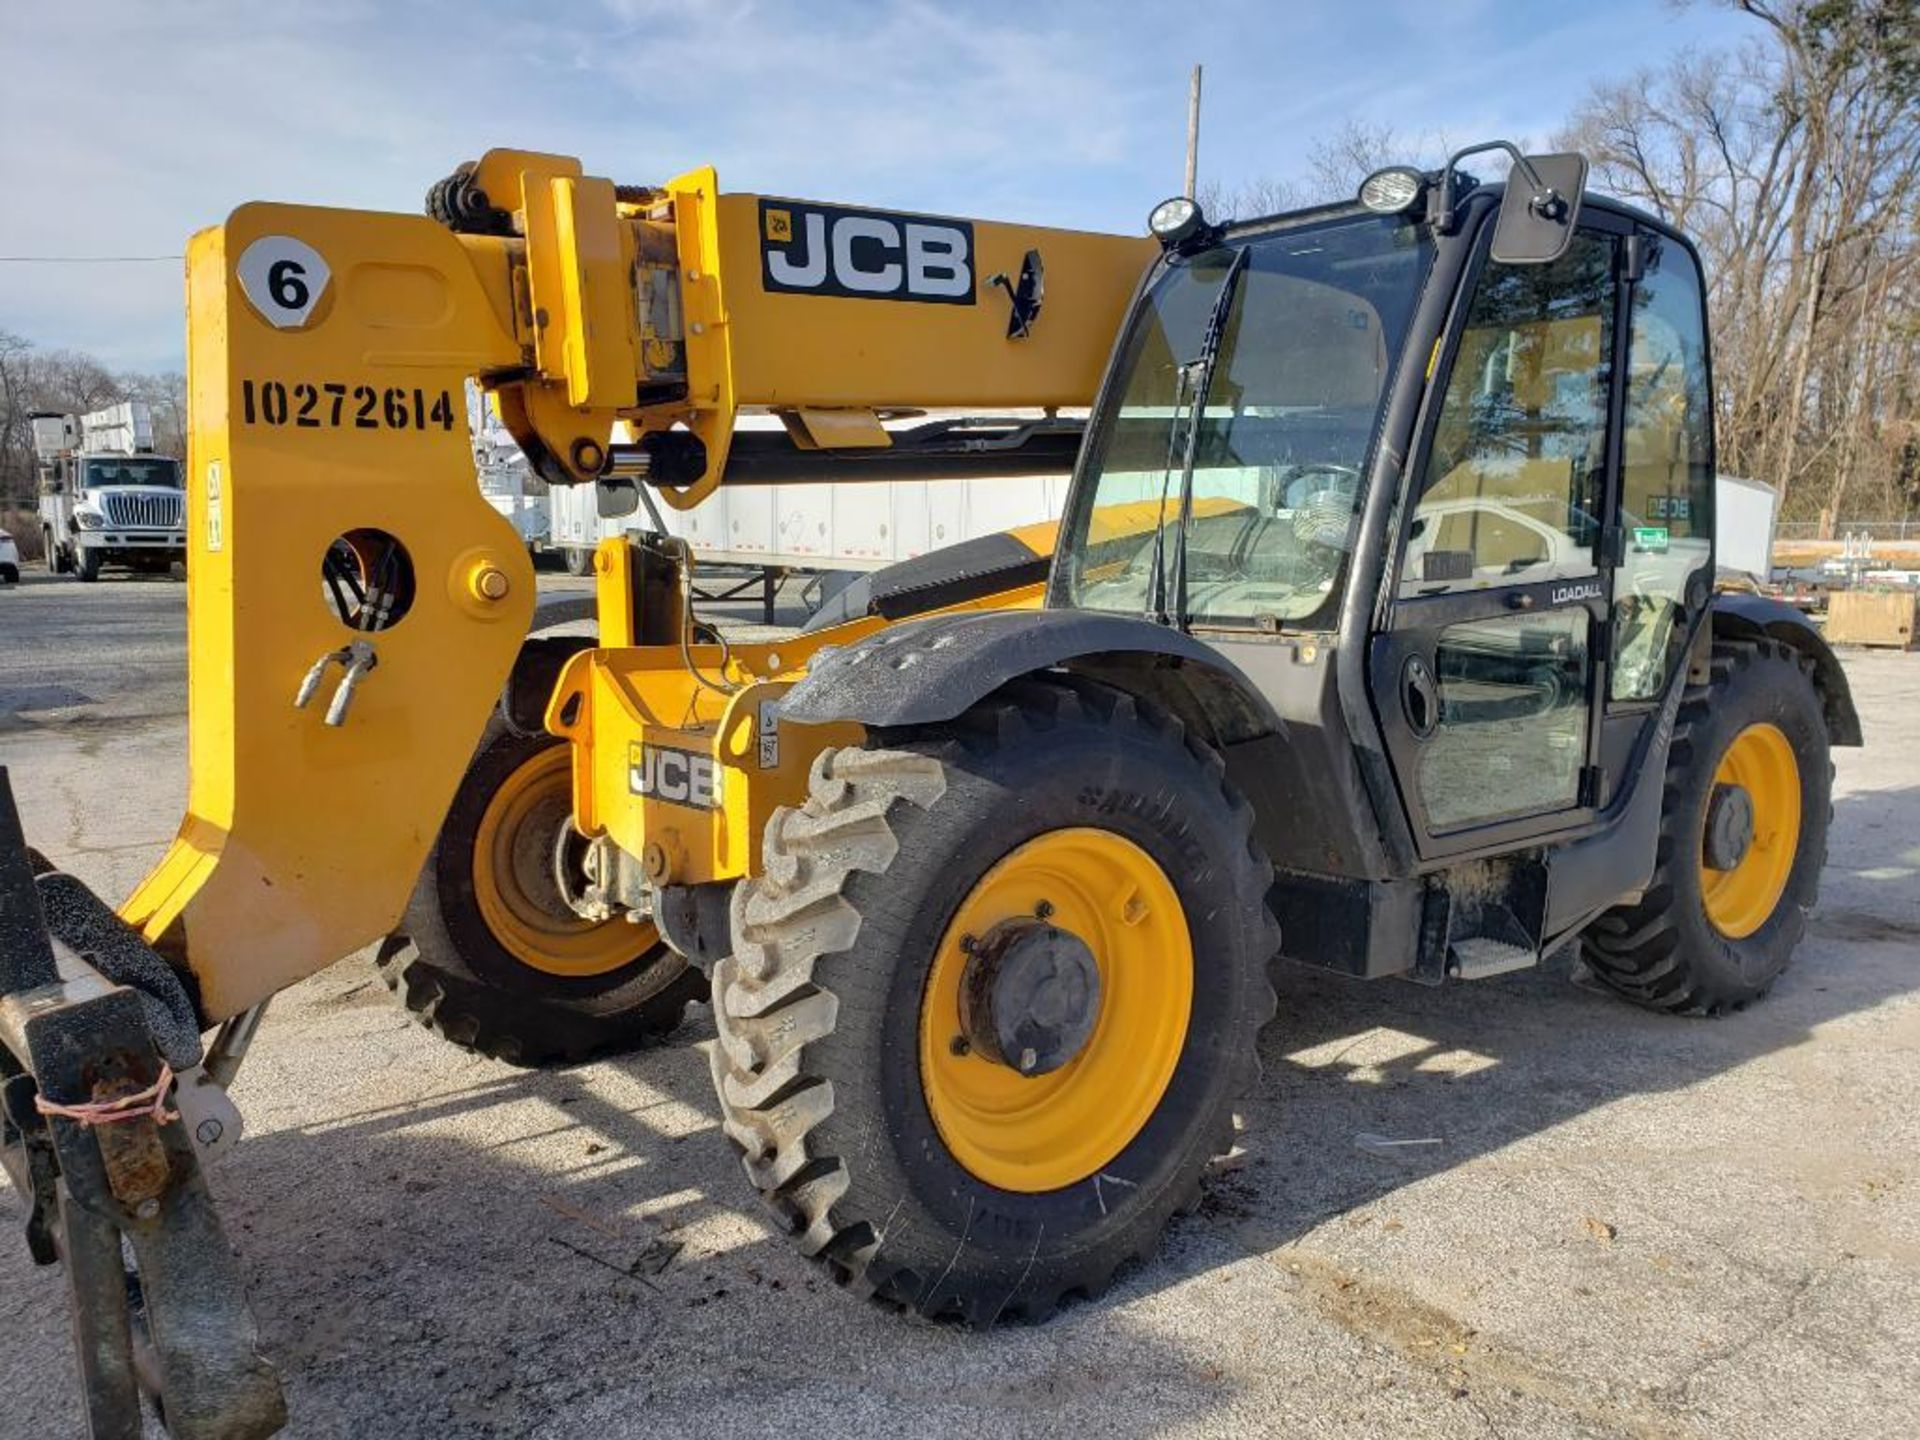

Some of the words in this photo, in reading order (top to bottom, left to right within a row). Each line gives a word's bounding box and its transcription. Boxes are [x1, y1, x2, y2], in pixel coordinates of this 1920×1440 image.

[768, 213, 971, 297] JCB
[268, 260, 309, 309] 6
[243, 380, 454, 431] 10272614
[1552, 584, 1602, 603] LOADALL
[631, 746, 722, 807] JCB
